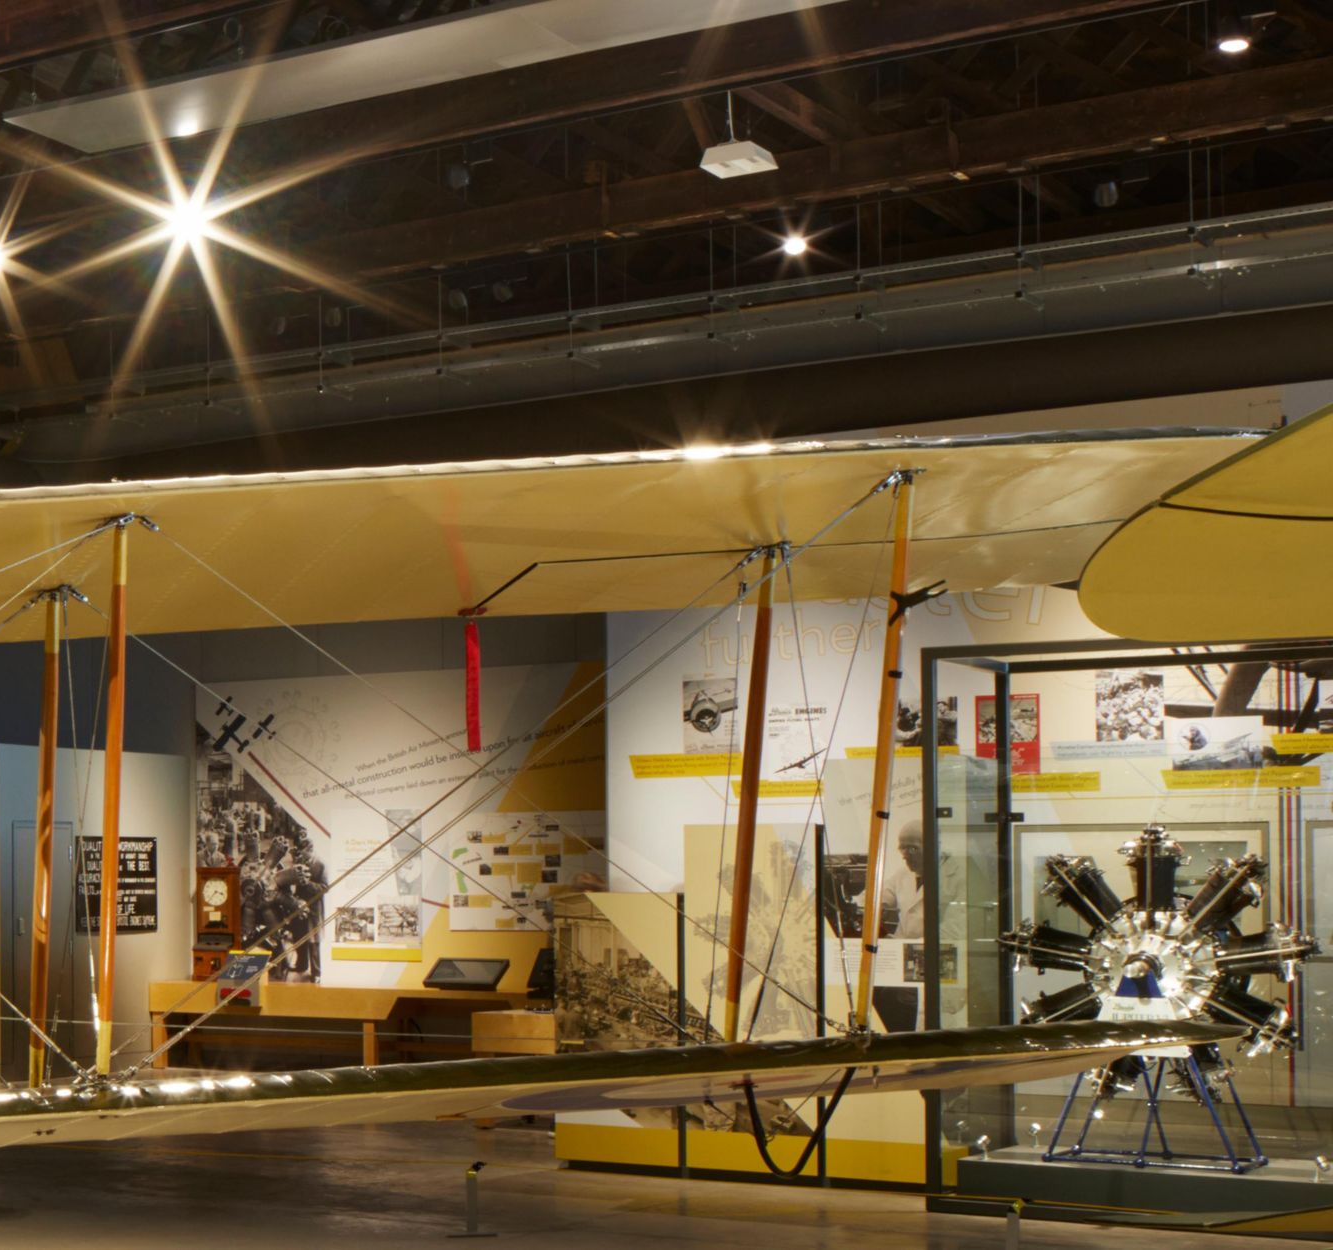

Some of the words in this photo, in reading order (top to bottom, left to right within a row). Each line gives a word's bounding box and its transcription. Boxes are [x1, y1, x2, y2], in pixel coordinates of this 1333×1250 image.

[700, 607, 882, 669] futher
[303, 787, 319, 799] that
[321, 777, 355, 794] all-metal
[356, 766, 408, 785] construction
[409, 756, 434, 771] would
[436, 753, 448, 764] be
[482, 740, 507, 753] upon
